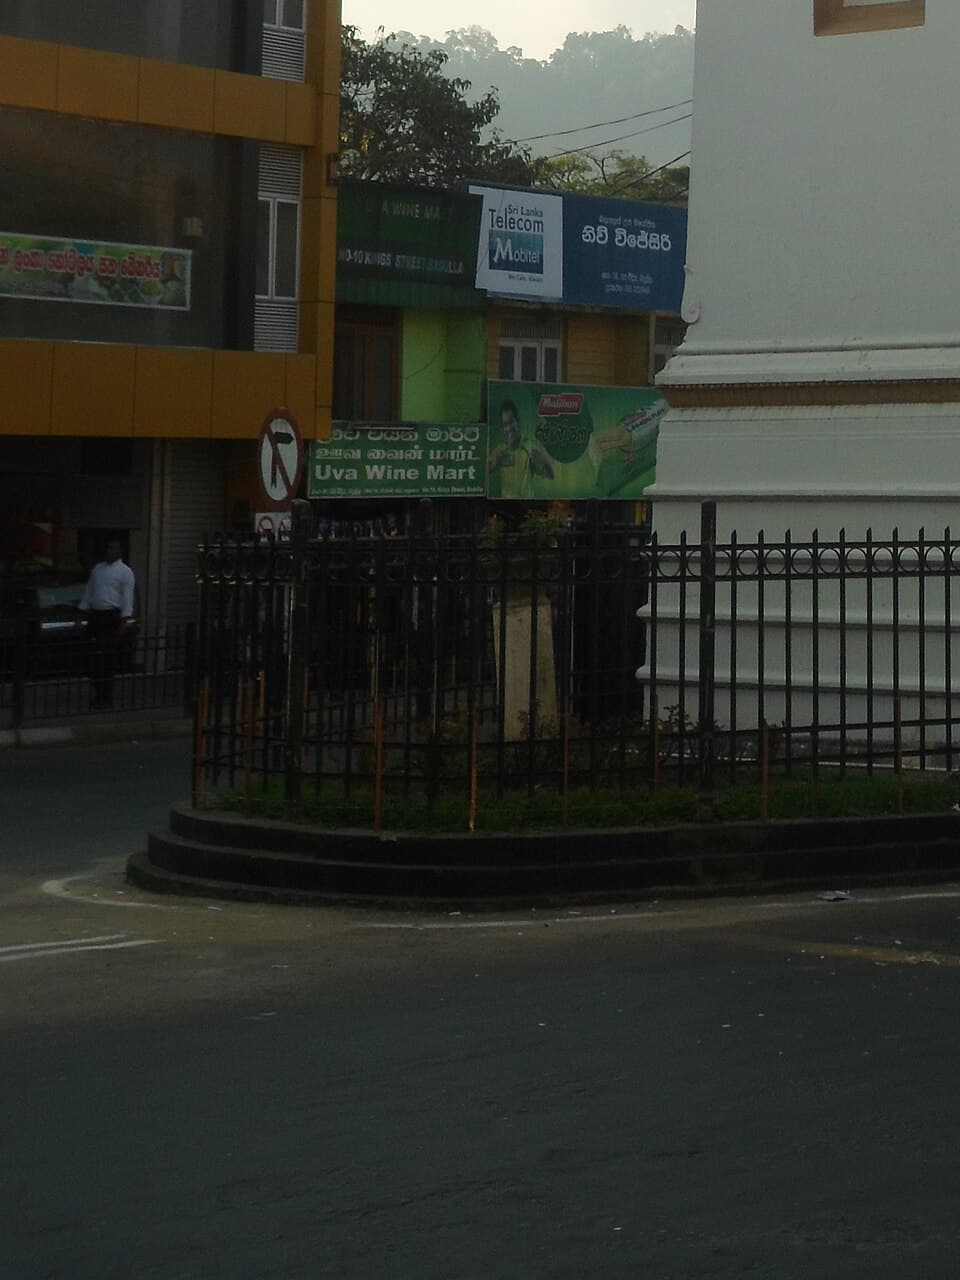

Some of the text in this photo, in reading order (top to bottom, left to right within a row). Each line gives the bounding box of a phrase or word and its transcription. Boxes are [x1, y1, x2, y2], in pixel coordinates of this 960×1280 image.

[489, 207, 544, 232] Telecom
[508, 205, 543, 218] Sri Lanka
[493, 237, 540, 265] Mobitel
[315, 465, 476, 480] Uva Wine Mart
